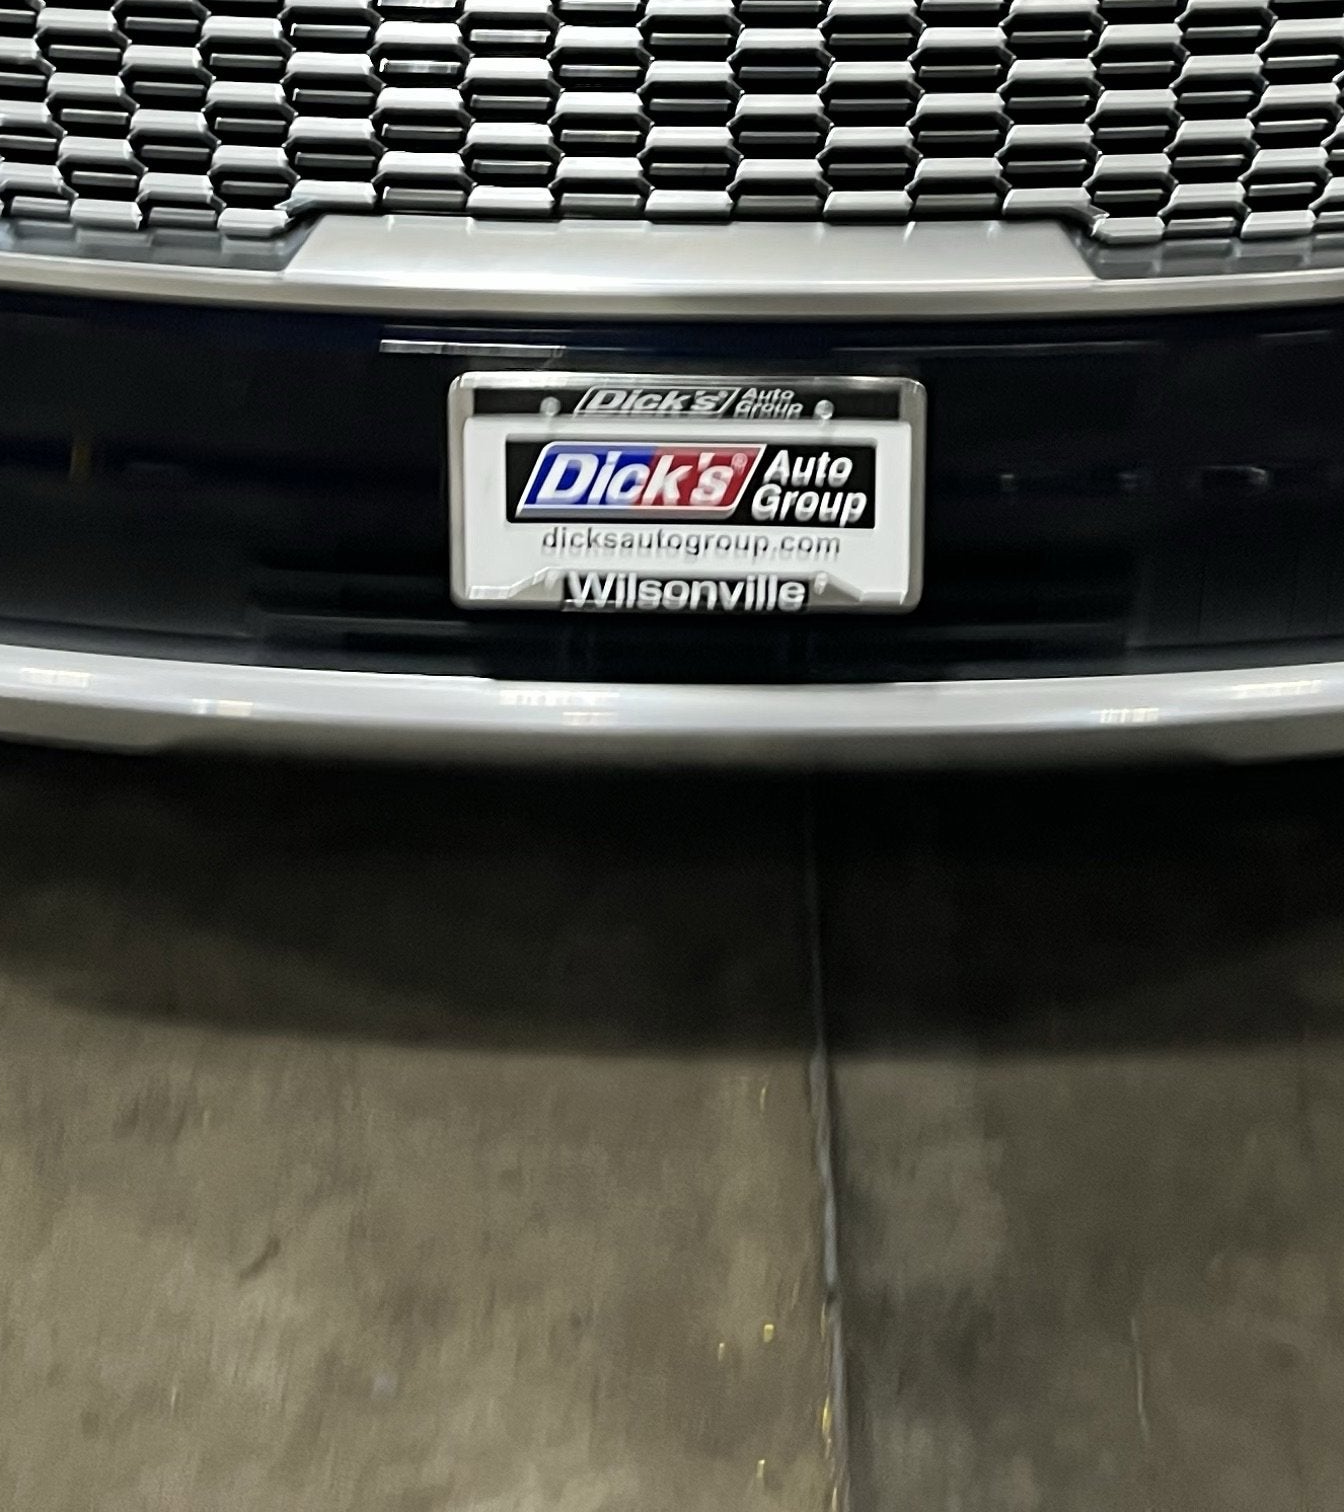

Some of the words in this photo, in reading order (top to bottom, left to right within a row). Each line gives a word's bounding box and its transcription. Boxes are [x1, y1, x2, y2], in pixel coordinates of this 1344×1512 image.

[734, 399, 805, 419] Group
[740, 387, 796, 401] Auto
[762, 449, 854, 488] Auto
[751, 482, 869, 529] Group
[541, 526, 841, 558] dicksautogroup.com
[566, 570, 808, 612] Wilsonville
